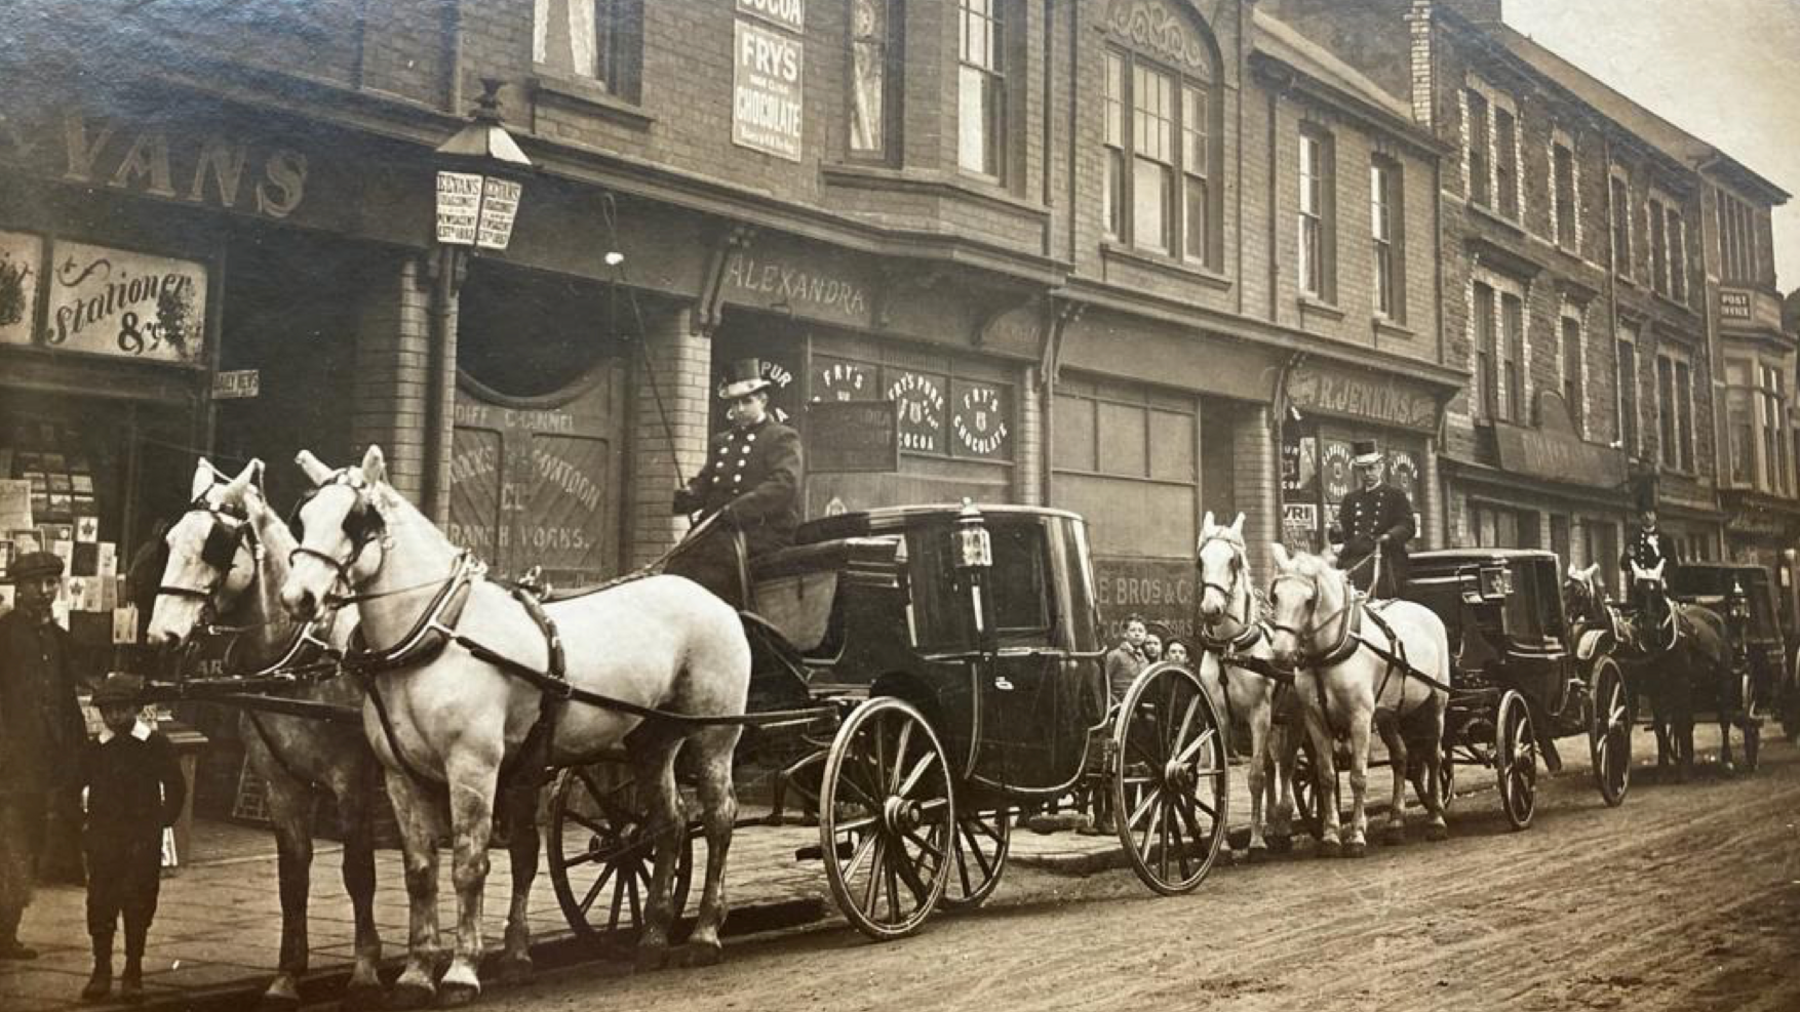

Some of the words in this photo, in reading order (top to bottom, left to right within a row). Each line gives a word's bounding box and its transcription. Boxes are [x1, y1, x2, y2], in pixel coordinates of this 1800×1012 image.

[737, 86, 801, 138] CHOCOLATE
[45, 270, 192, 345] Stationer
[724, 254, 866, 315] ALEXANDRA
[823, 363, 864, 390] FRY'S
[962, 386, 1000, 414] FRY'S
[952, 413, 1008, 454] CHOCOLATE
